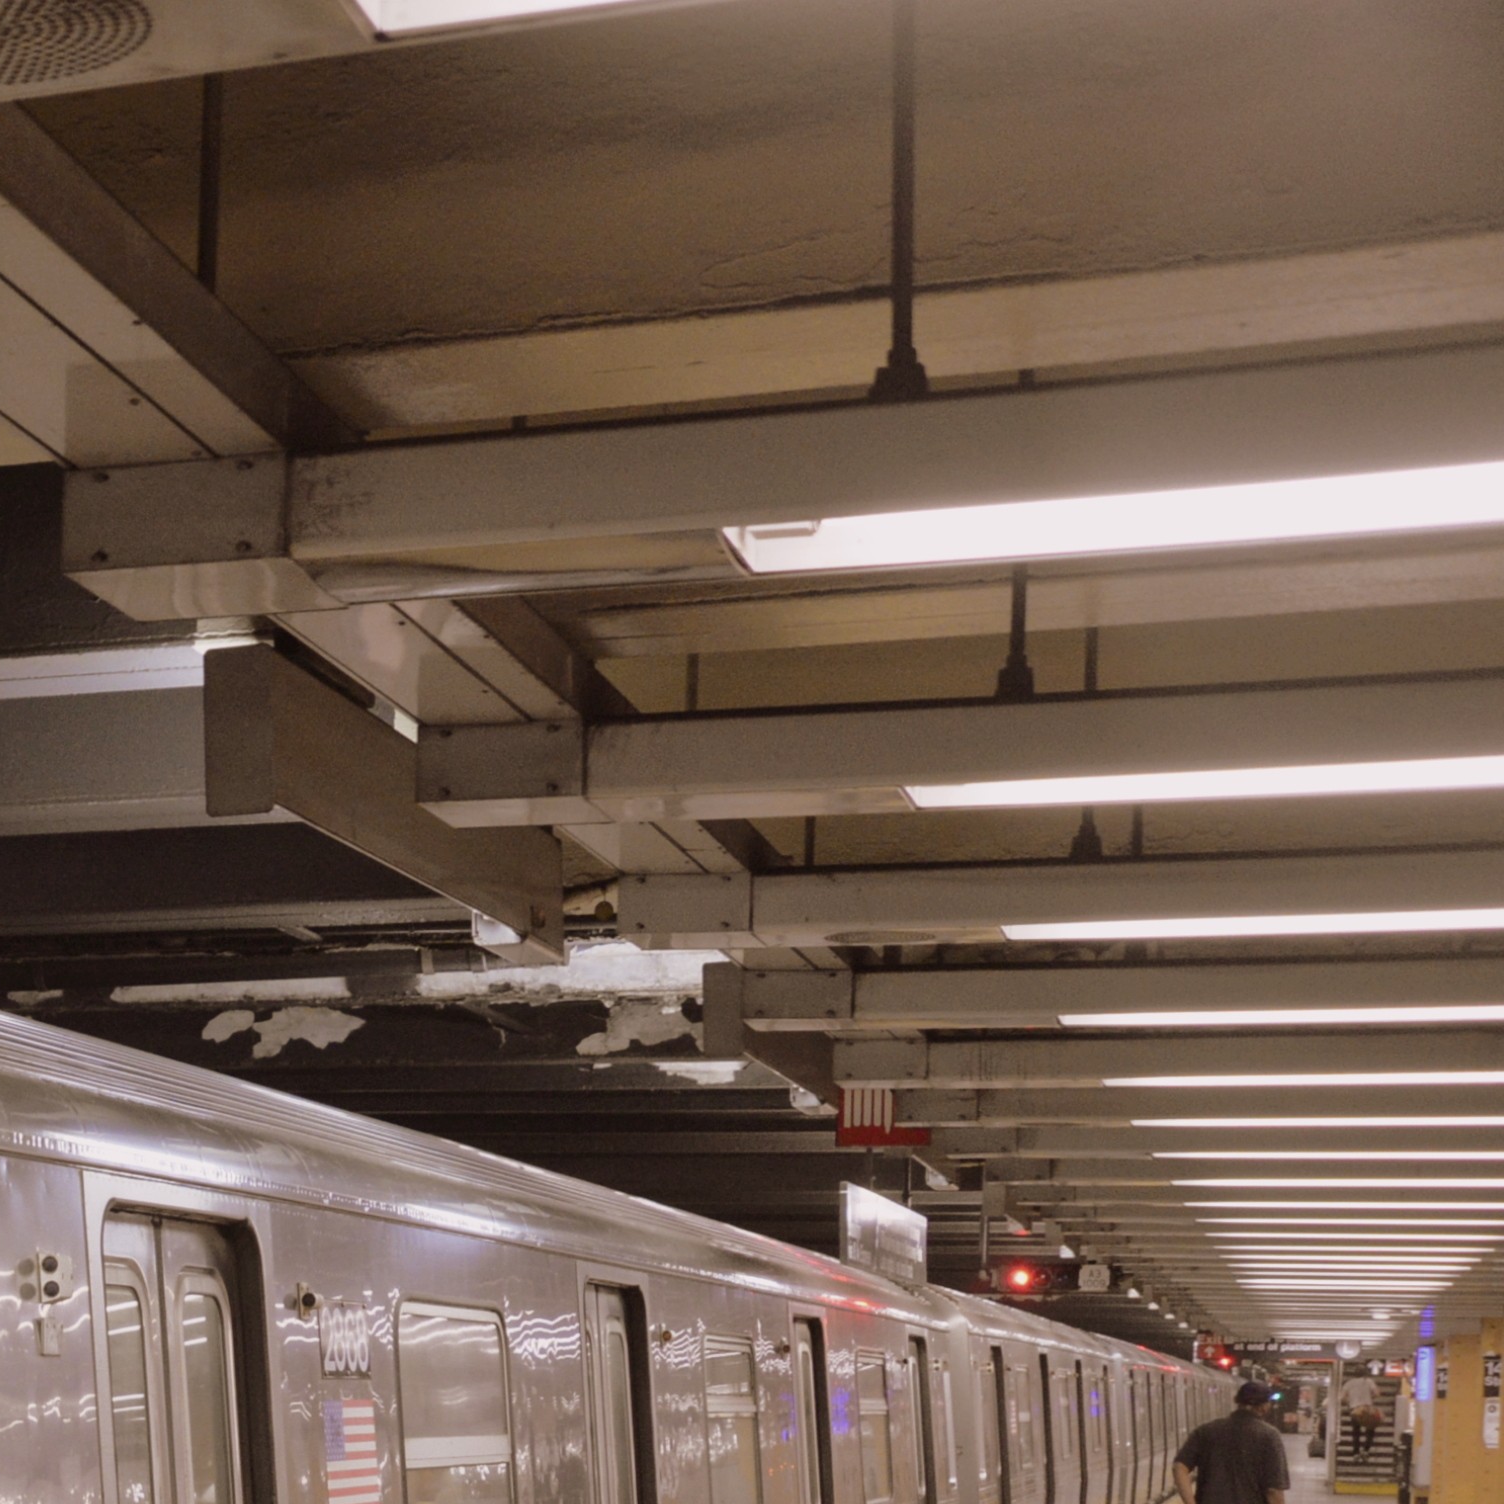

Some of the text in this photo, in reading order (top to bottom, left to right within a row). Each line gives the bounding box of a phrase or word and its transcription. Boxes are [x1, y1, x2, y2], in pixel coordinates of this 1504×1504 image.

[321, 1307, 369, 1372] 2868
[1247, 1341, 1265, 1351] end
[1267, 1341, 1279, 1351] of
[1280, 1342, 1322, 1352] platform
